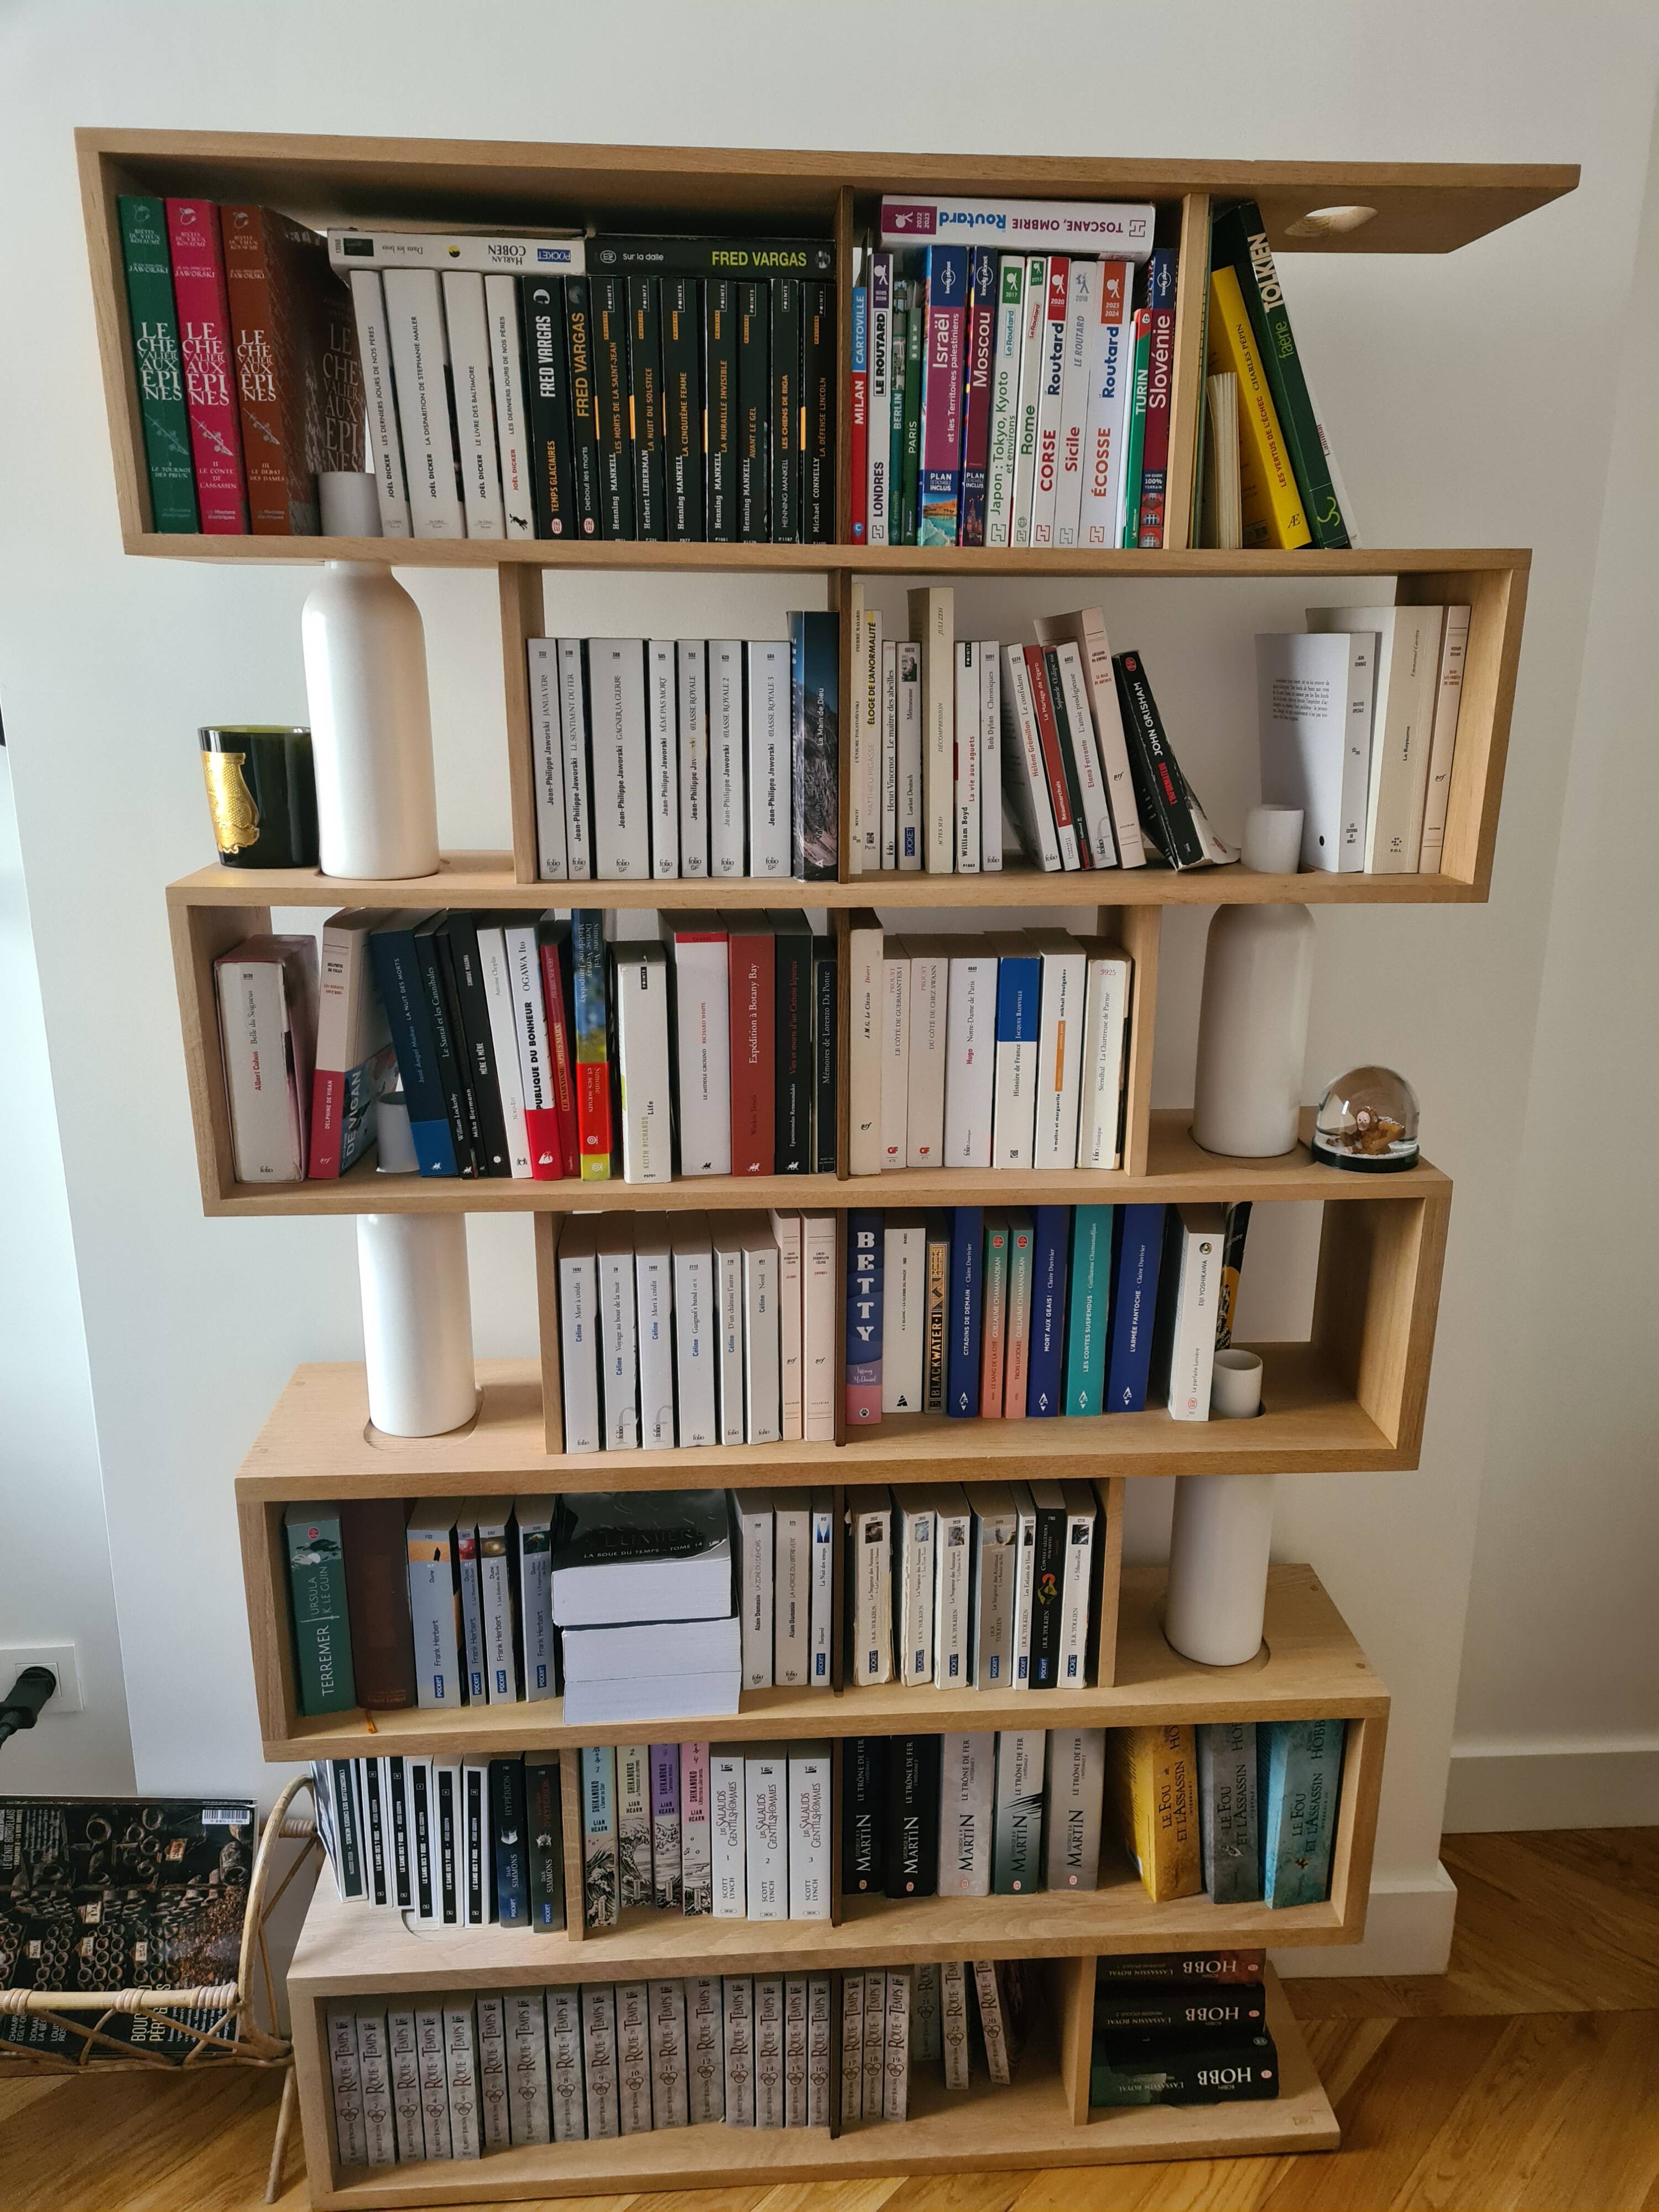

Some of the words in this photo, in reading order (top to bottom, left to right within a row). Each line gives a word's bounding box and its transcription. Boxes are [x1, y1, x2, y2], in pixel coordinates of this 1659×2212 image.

[940, 212, 1006, 229] Routard
[1012, 218, 1059, 231] OMBRIE
[1063, 218, 1123, 233] TOSCANE,
[489, 245, 525, 256] COBEN
[492, 257, 522, 265] HARLAN
[538, 249, 570, 260] POCKET
[712, 252, 748, 265] FRED
[753, 252, 807, 267] VARGAS
[1248, 233, 1284, 312] TOLKIEN
[142, 322, 170, 339] LE
[187, 322, 217, 340] LE
[536, 316, 553, 363] VARGAS
[572, 313, 586, 372] VARGAS
[855, 296, 864, 363] CARTOVILLE
[933, 314, 950, 368] Israël
[950, 314, 959, 368] palestiniens
[1236, 324, 1250, 350] PÉPIN
[137, 340, 177, 353] CHE
[139, 351, 178, 361] VALIER
[182, 340, 223, 354] CHE
[184, 353, 224, 363] VALIER
[875, 314, 885, 376] ROUTARD
[973, 312, 991, 387] Moscou
[1047, 323, 1063, 395] Routard
[140, 359, 178, 372] AUX
[186, 362, 226, 374] AUX
[415, 343, 423, 380] STEPHANIE
[1102, 326, 1119, 398] Routard
[1150, 315, 1171, 408] Slovénie
[1244, 351, 1260, 390] CHARLES
[143, 372, 179, 387] EPI
[145, 387, 182, 400] NES
[188, 374, 227, 391] EPI
[418, 382, 424, 390] DE
[539, 368, 556, 397] FRED
[875, 379, 885, 394] LE
[948, 371, 957, 416] Territoires
[996, 372, 1010, 413] Kyoto
[1135, 369, 1147, 415] TURIN
[190, 391, 229, 405] NES
[576, 378, 589, 416] FRED
[854, 381, 864, 425] MILAN
[893, 393, 902, 429] BERLIN
[420, 393, 430, 435] DISPARITION
[680, 401, 688, 444] CINQUIÈME
[908, 421, 917, 453] PARIS
[948, 434, 954, 442] et
[994, 417, 1009, 462] Tokyo,
[1021, 405, 1035, 455] Rome
[547, 441, 557, 485] GLACIAIRES
[681, 447, 688, 456] LA
[1040, 430, 1056, 492] CORSE
[1066, 426, 1080, 472] Sicile
[1093, 428, 1111, 497] ÉCOSSE
[550, 487, 559, 512] TEMPS
[873, 462, 884, 517] LONDRES
[990, 473, 1004, 515] Japon
[677, 497, 686, 529] Henning
[867, 622, 876, 684] L'ANORMALITÉ
[869, 685, 875, 696] DE
[1069, 674, 1082, 712] prodigieuse
[1134, 682, 1153, 727] GRISHAM
[867, 698, 875, 724] ÉLOGE
[887, 739, 894, 748] Le
[1081, 740, 1091, 768] Ferrante
[1149, 729, 1162, 755] JOHN
[1085, 770, 1094, 787] Elena
[618, 780, 627, 828] Jean-Philippe
[1055, 781, 1067, 820] Beaumarchais
[961, 807, 969, 826] Boyd
[518, 941, 526, 953] Ito
[520, 956, 530, 991] OGAWA
[749, 964, 759, 979] Bay
[749, 981, 759, 1010] Botany
[524, 1002, 536, 1046] BONHEUR
[749, 1020, 759, 1063] Expédition
[530, 1050, 538, 1063] DU
[966, 1049, 974, 1064] Hugo
[1199, 1260, 1208, 1296] YOSHIKAWA
[964, 1316, 970, 1325] DE
[614, 1332, 623, 1351] Voyage
[931, 1324, 942, 1396] BLACKWATER
[309, 1577, 320, 1615] URSULA
[317, 1625, 335, 1695] TERREMER
[962, 1754, 969, 1764] DE
[1159, 1785, 1171, 1813] FOU
[1162, 1814, 1172, 1829] LE
[856, 1814, 871, 1871] MARTIN
[958, 1814, 974, 1871] MARTIN
[1183, 1961, 1237, 1973] HOBB
[451, 2026, 469, 2054] TEMPS
[453, 2062, 471, 2087] ROUE
[1198, 2067, 1251, 2085] HOBB
